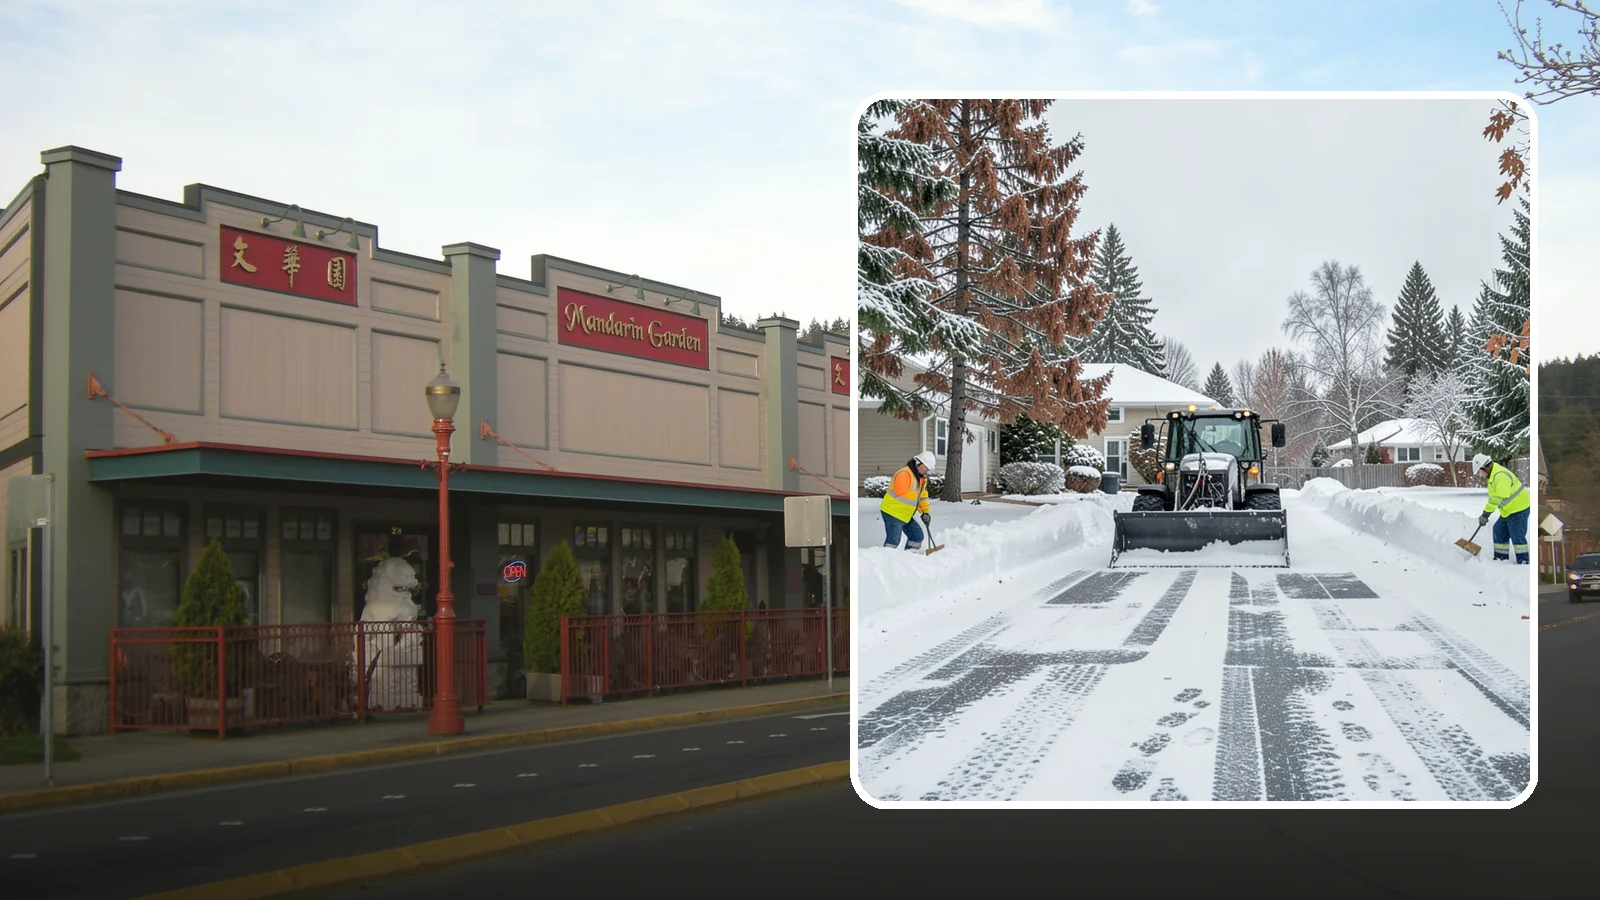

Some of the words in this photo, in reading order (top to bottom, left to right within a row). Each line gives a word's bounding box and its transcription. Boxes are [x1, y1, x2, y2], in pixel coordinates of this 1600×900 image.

[231, 236, 346, 291] 文華園
[564, 302, 644, 341] Mandarin
[648, 320, 701, 352] Garden
[835, 363, 846, 386] 文
[503, 565, 527, 578] OPEN
